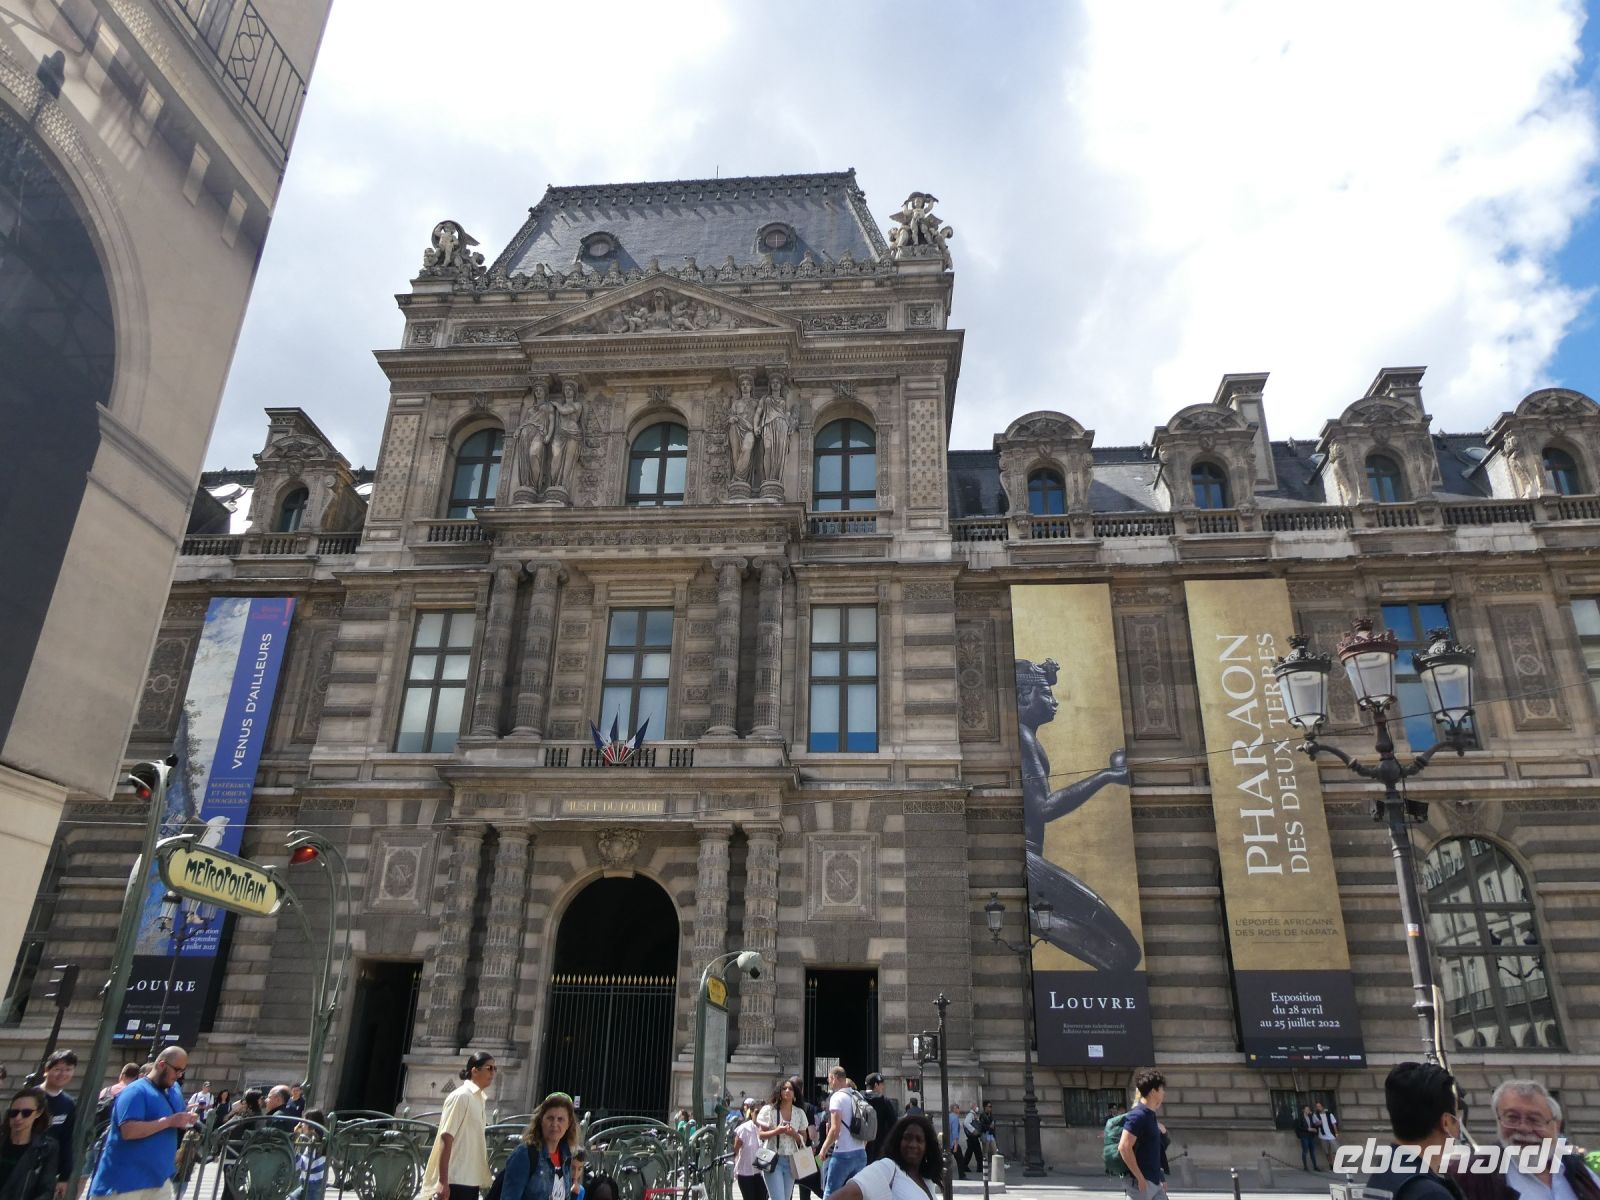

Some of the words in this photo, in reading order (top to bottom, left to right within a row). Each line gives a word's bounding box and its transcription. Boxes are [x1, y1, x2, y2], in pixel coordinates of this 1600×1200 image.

[231, 717, 254, 770] VENUS
[245, 632, 273, 713] D'AILLEURS
[1256, 632, 1288, 729] TERRES
[1216, 633, 1284, 877] PHARAON
[1273, 736, 1302, 811] DEUX
[1285, 820, 1311, 874] DES
[184, 857, 267, 905] METROPOLITAIN
[1234, 928, 1255, 937] DES
[1257, 928, 1281, 937] ROIS
[1284, 928, 1298, 937] DE
[1300, 927, 1339, 936] NAPATA
[1283, 917, 1335, 927] AFRICAINE
[1270, 992, 1322, 1005] Exposition
[1272, 1004, 1286, 1015] du
[1288, 1004, 1300, 1015] 28
[1301, 1004, 1324, 1015] avril
[1260, 1019, 1272, 1028] au
[1274, 1020, 1286, 1030] 25
[1287, 1018, 1316, 1030] juillet
[1318, 1020, 1341, 1029] 2022
